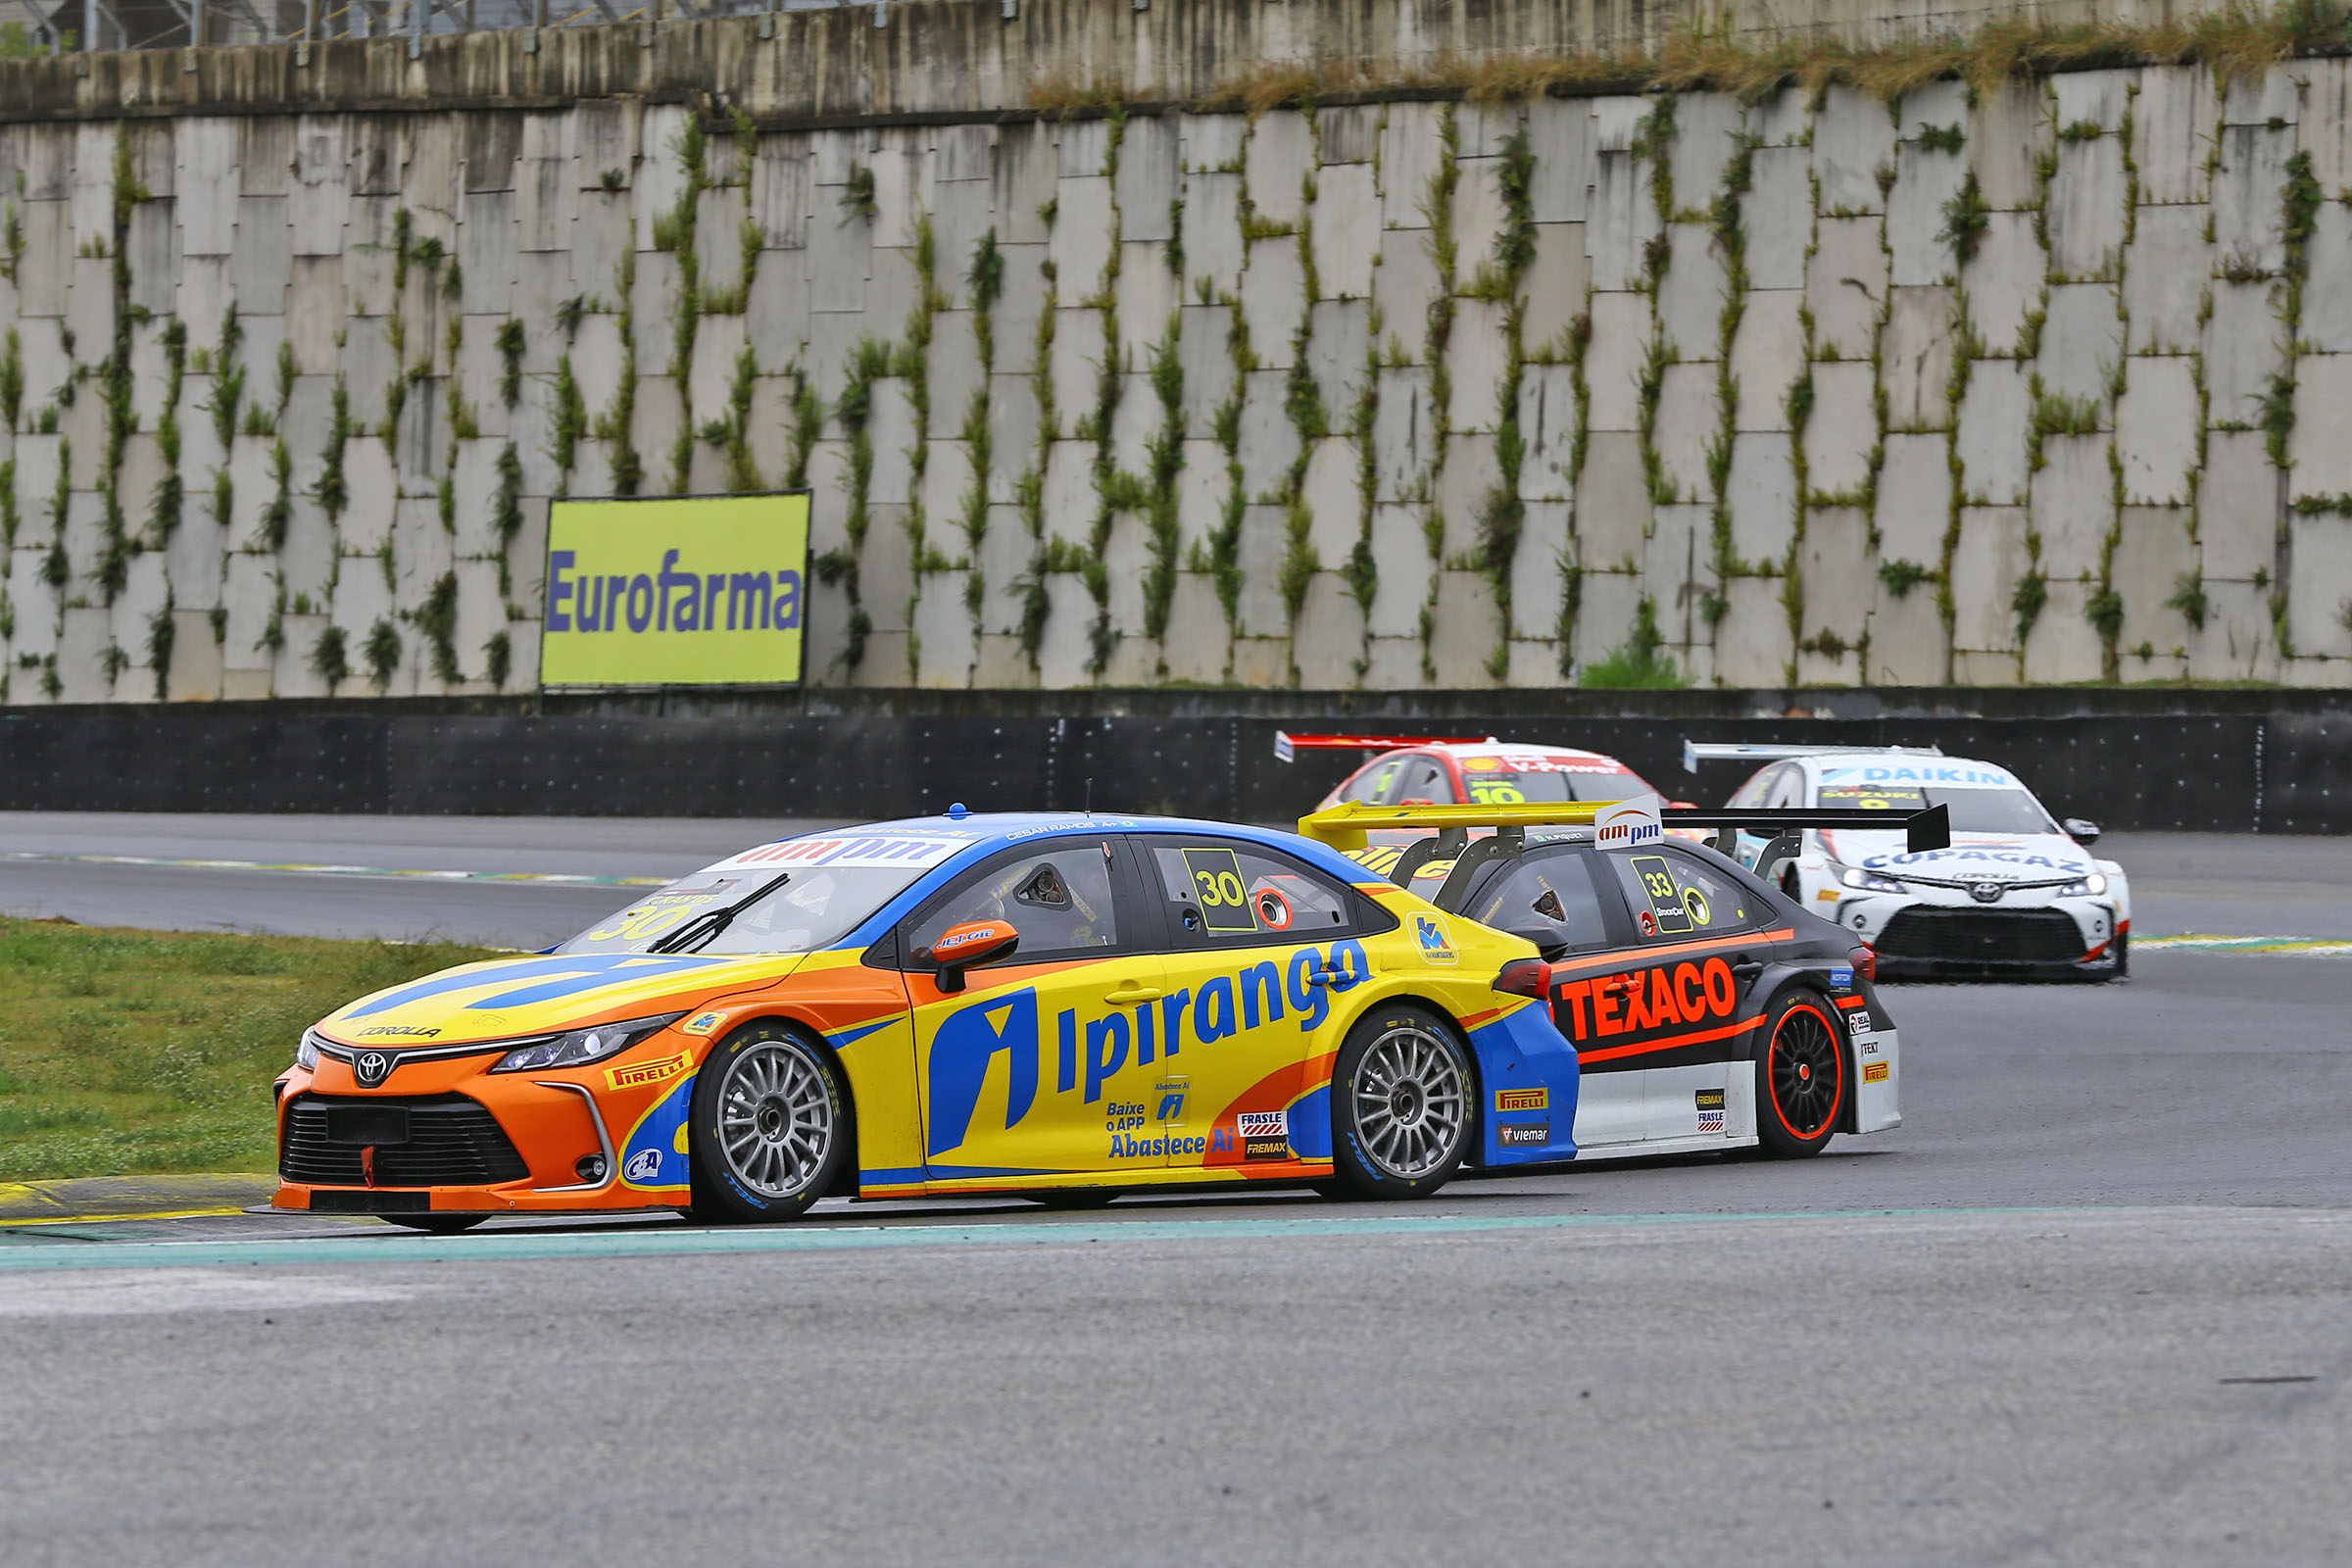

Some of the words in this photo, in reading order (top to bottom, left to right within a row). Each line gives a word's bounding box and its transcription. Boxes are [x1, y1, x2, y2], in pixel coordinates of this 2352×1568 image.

[547, 549, 802, 633] Eurofarma
[1865, 768, 2006, 784] DAIKIN
[1470, 788, 1525, 804] 10
[1822, 791, 1920, 800] SUZUKI
[1051, 821, 1096, 833] RAMOS
[1599, 824, 1659, 845] ampm
[1863, 851, 2084, 873] COPAGAZ
[1196, 871, 1245, 907] 30
[1645, 872, 1674, 898] 33
[589, 906, 694, 941] 30
[1561, 956, 1737, 1041] TEXACO
[1057, 939, 1376, 1104] Ipiranga
[356, 1026, 442, 1038] COROLLA
[612, 1054, 683, 1086] PIRELLI
[1865, 1063, 1887, 1081] PIRELLI
[1106, 1102, 1145, 1116] Baixe
[1499, 1091, 1544, 1109] PIRELLI
[1117, 1116, 1145, 1131] APP
[1513, 1129, 1547, 1141] viemar
[1108, 1133, 1205, 1158] Abastece
[1247, 1143, 1286, 1153] FREMAX
